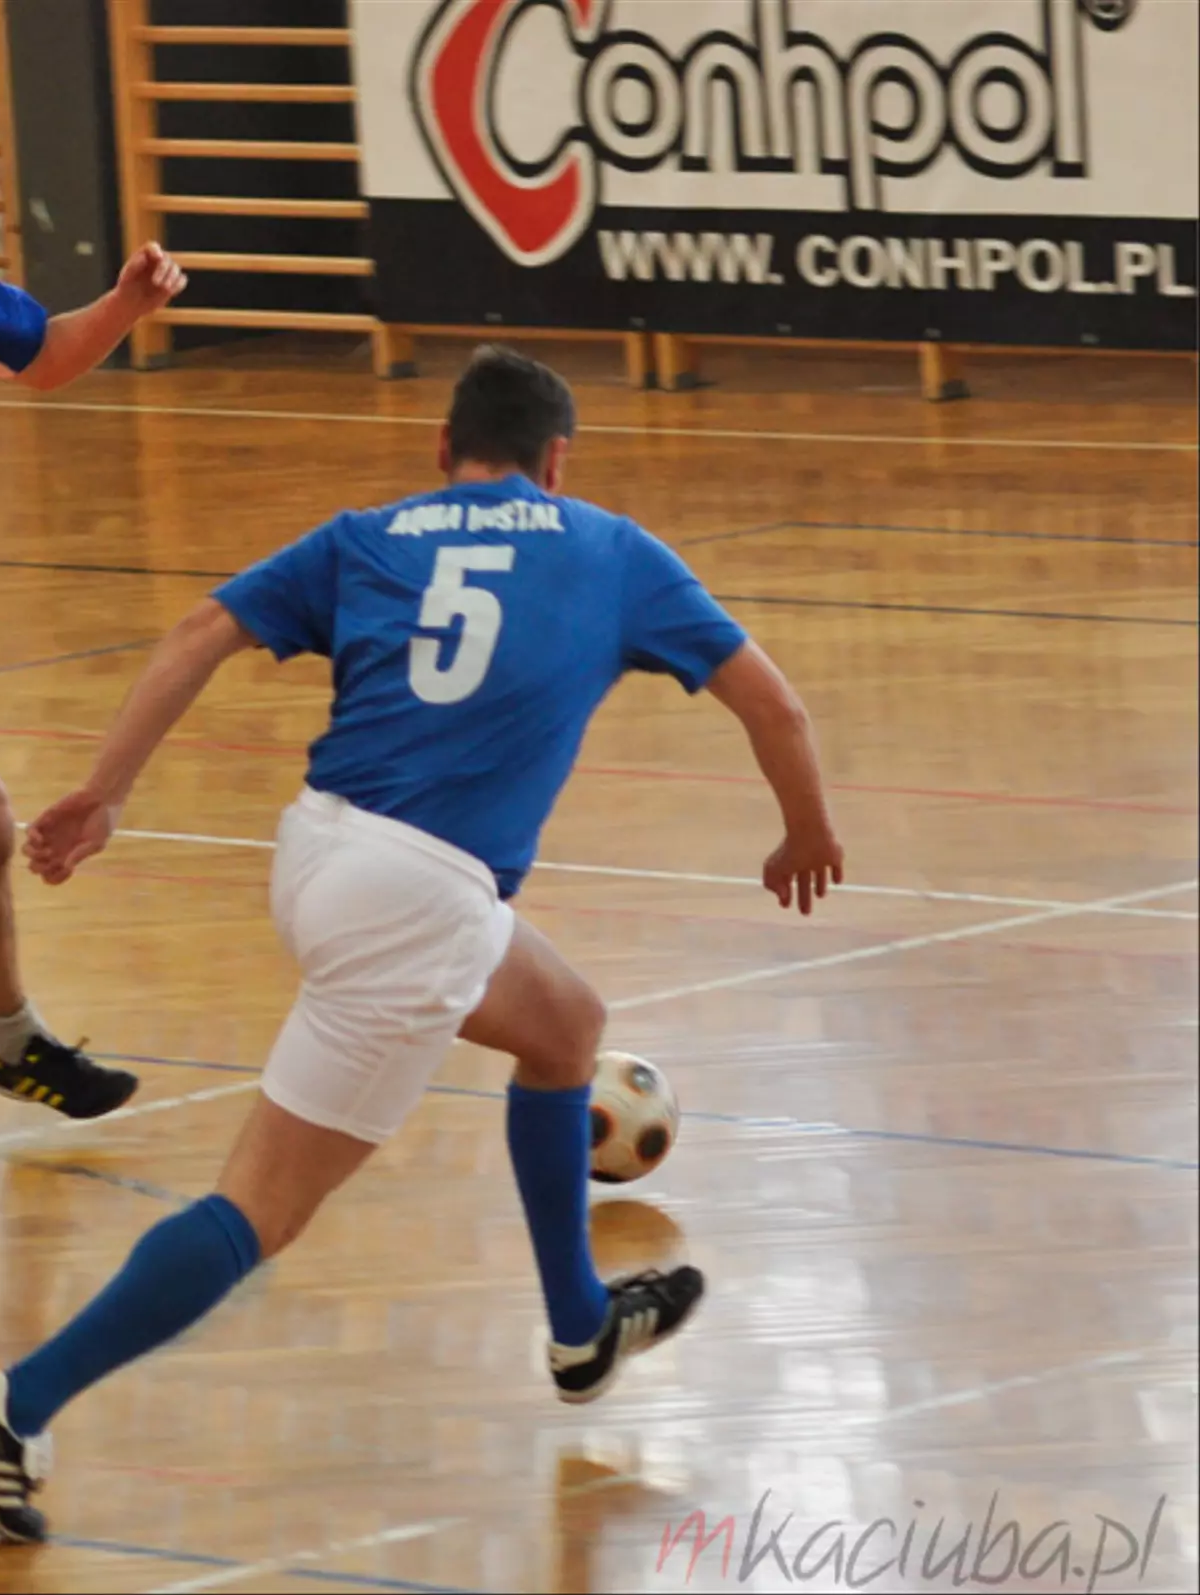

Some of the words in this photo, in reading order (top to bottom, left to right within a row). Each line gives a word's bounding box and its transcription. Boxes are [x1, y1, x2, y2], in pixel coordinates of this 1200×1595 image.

[409, 0, 1089, 267] Conhpol
[599, 230, 784, 283] WWW.
[798, 235, 1196, 296] CONHPOL.PL
[408, 545, 516, 704] 5
